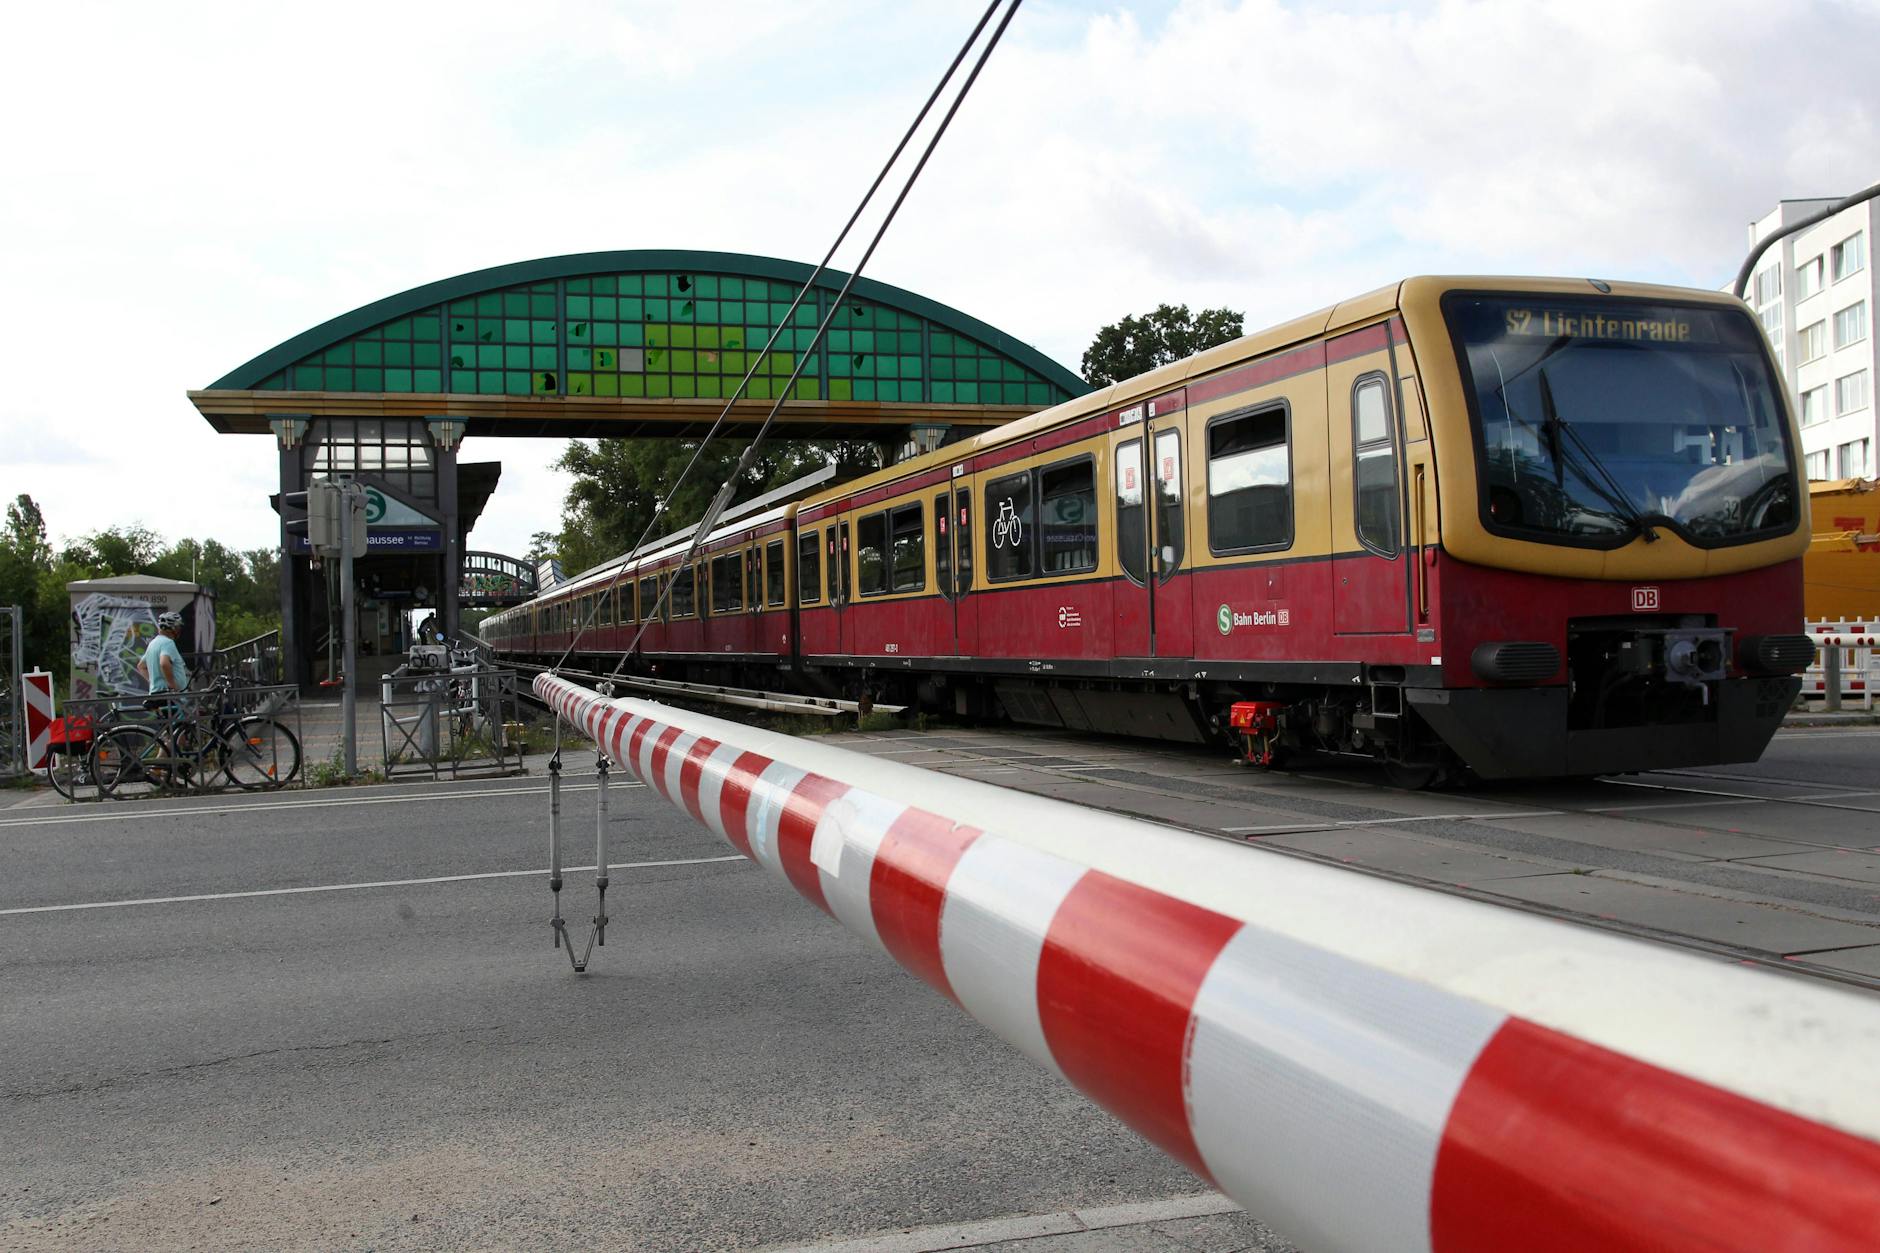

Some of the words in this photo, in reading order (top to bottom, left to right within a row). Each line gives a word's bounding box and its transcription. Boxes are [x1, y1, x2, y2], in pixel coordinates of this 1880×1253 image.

[1506, 309, 1532, 335] S2
[1543, 311, 1690, 342] Lichtenrade
[366, 536, 404, 545] aussee
[1634, 589, 1658, 608] DB
[1218, 606, 1231, 633] S
[1233, 612, 1252, 626] Bahn
[1253, 611, 1276, 625] Berlin
[1279, 610, 1289, 624] DB
